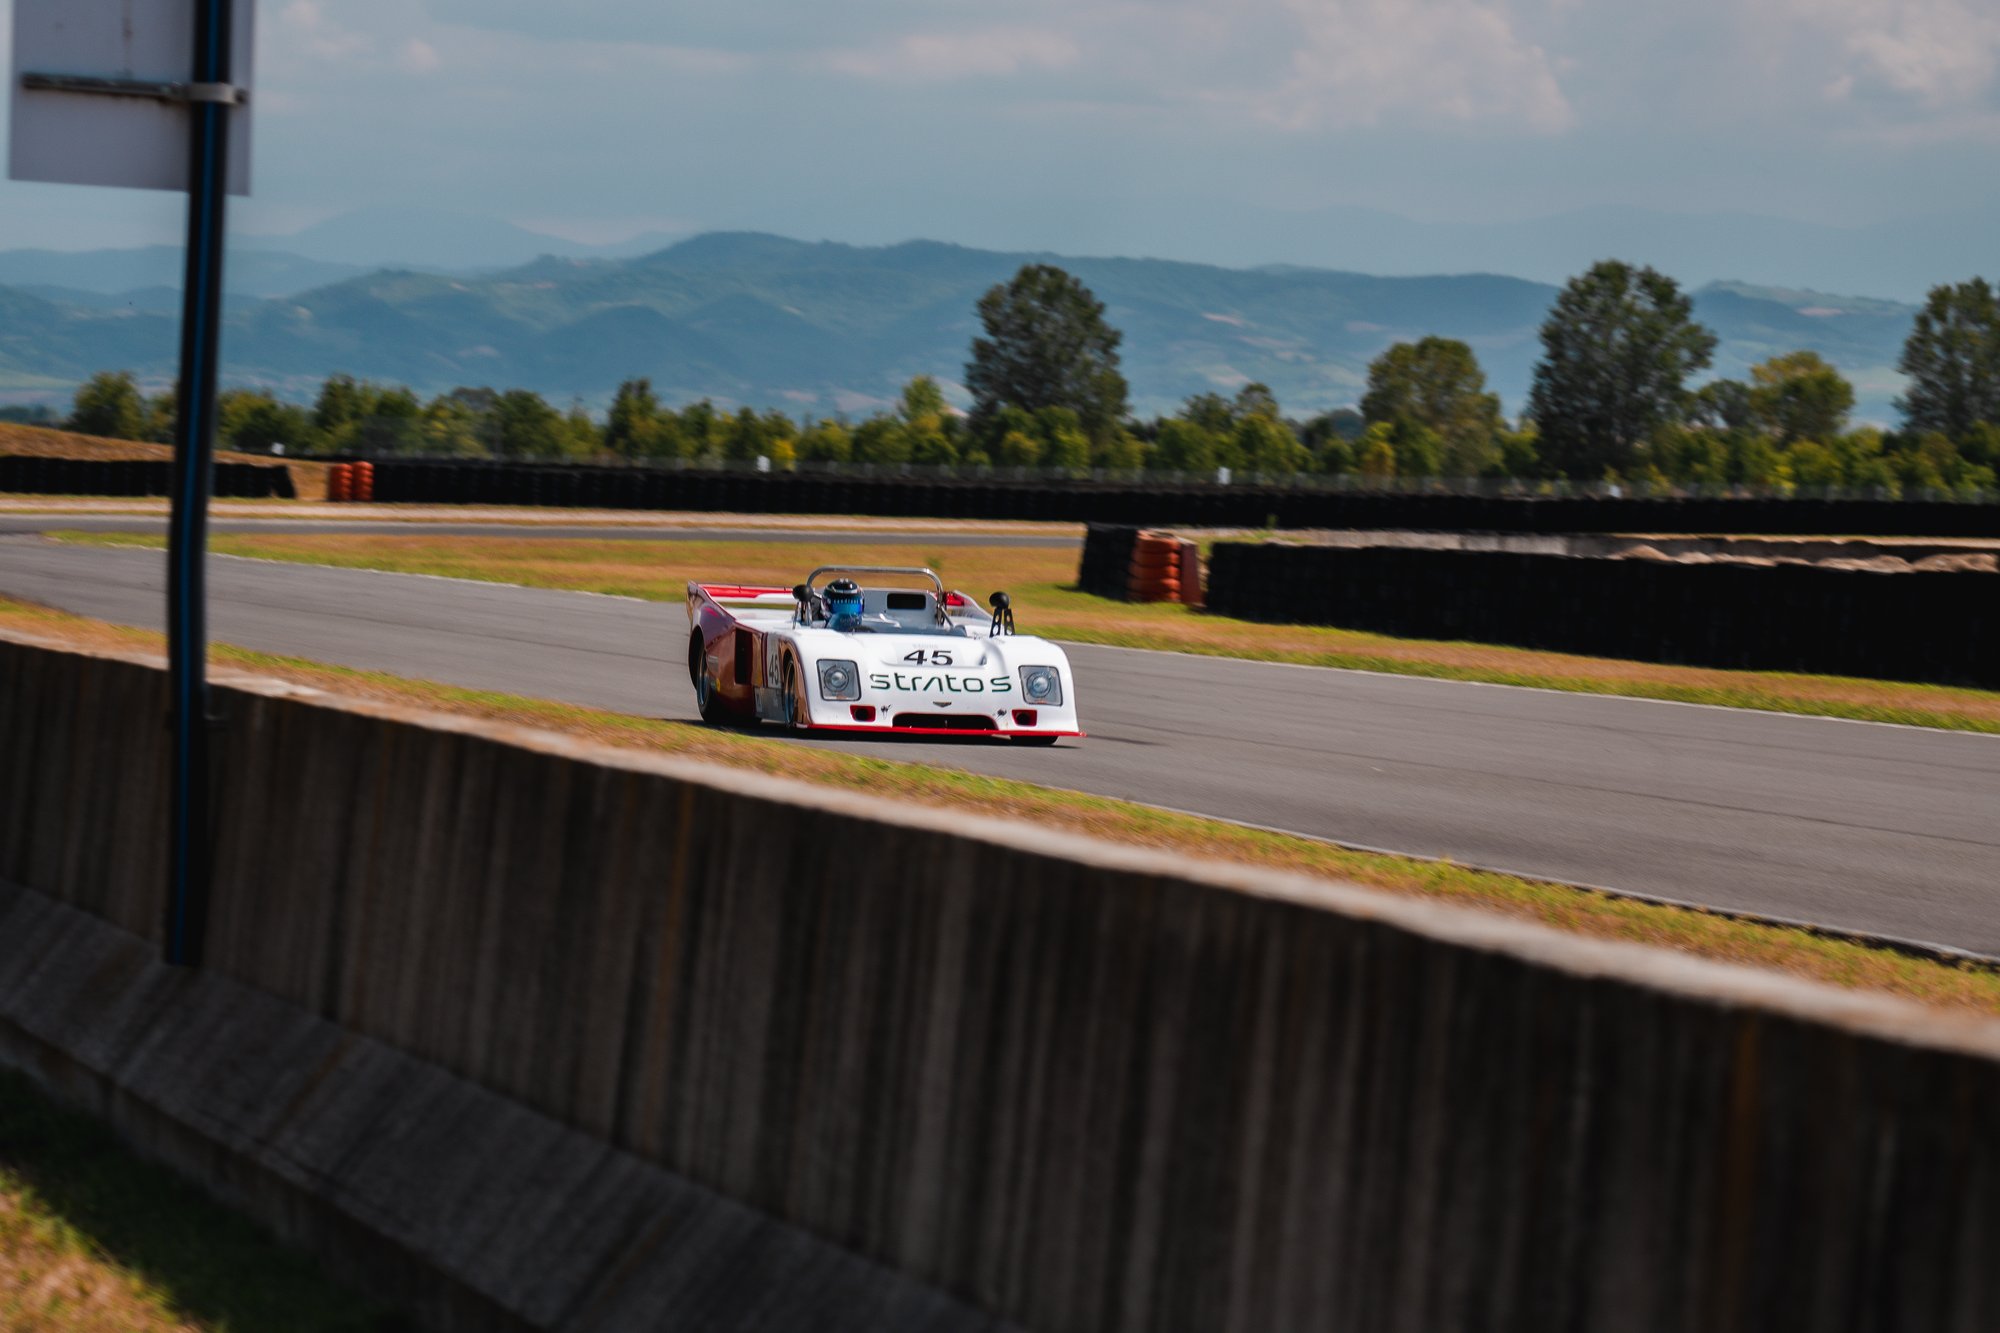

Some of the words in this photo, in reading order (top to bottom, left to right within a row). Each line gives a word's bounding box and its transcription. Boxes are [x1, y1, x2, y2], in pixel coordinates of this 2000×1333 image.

[903, 649, 954, 666] 45
[768, 654, 780, 686] 45
[869, 672, 1012, 693] stratos
